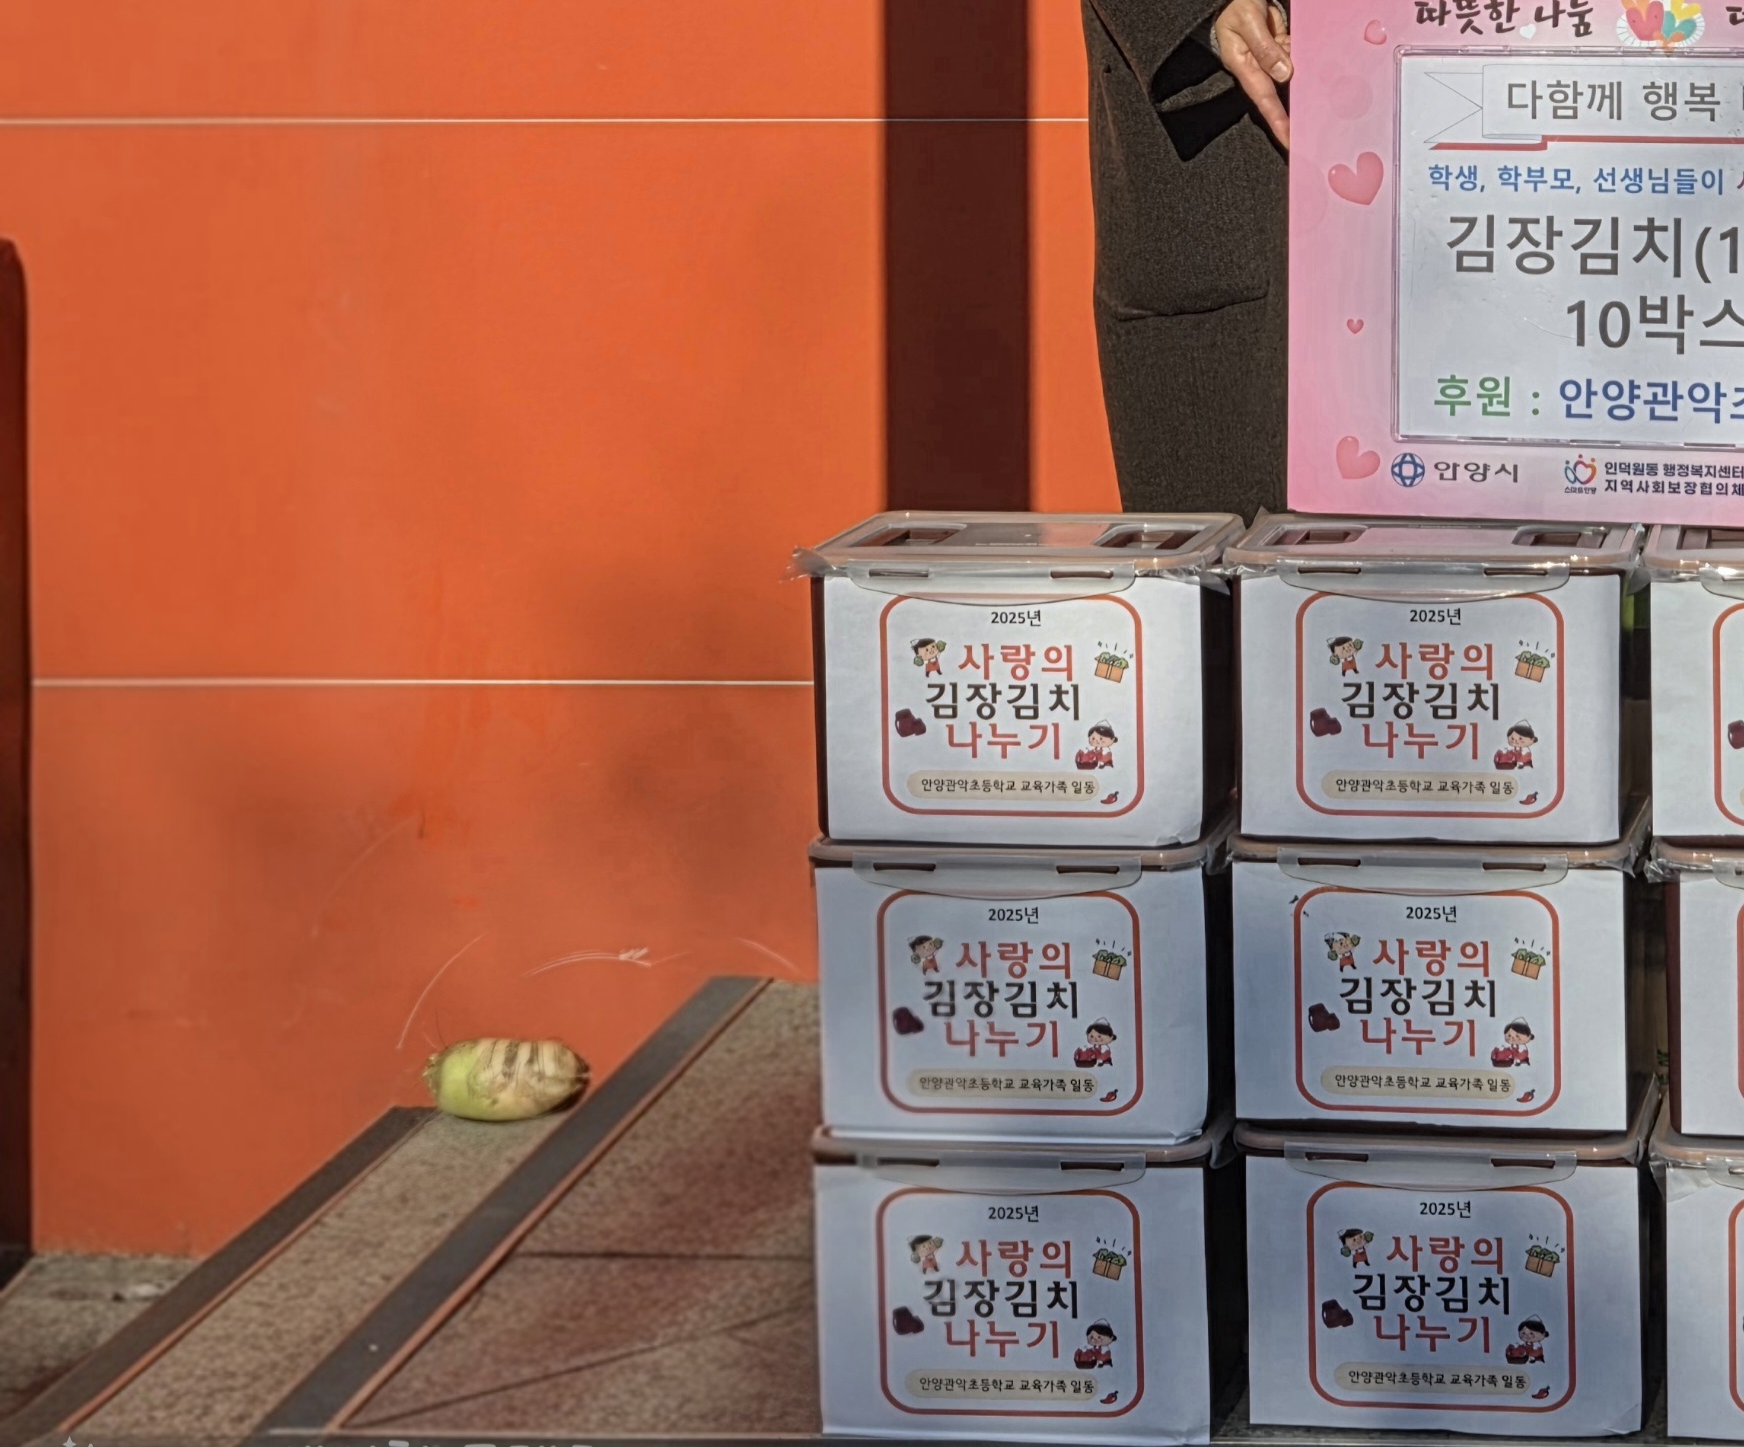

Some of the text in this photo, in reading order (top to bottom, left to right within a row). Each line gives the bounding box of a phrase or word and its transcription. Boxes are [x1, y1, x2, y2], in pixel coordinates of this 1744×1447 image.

[1507, 79, 1622, 121] 다함께
[1642, 81, 1721, 122] 행복
[1428, 164, 1486, 193] 학생,
[1498, 165, 1582, 195] 학부모,
[1593, 167, 1723, 196] 선생님들이
[1434, 374, 1511, 418] 후원
[1433, 461, 1519, 483] 안양시
[1604, 462, 1744, 479] 인덕원동 행정복지센터
[1604, 479, 1744, 496] 지역사회보장협의체
[990, 609, 1042, 627] 2025년
[1409, 607, 1462, 626] 2025년
[957, 642, 1074, 682] 사랑의
[1374, 641, 1494, 681] 사랑의
[925, 681, 1080, 721] 김장김치
[1341, 680, 1500, 721] 김장김치
[945, 721, 1060, 760] 나누기
[1361, 720, 1479, 761] 나누기
[921, 777, 1096, 795] 안양관악초등학교 교육가족 일동
[1335, 778, 1515, 796] 안양관악초등학교 교육가족 일동
[987, 906, 1039, 924] 2025년
[1405, 904, 1458, 922] 2025년
[955, 940, 1071, 980] 사랑의
[1372, 937, 1490, 978] 사랑의
[923, 979, 1078, 1019] 김장김치
[1339, 976, 1496, 1018] 김장김치
[943, 1019, 1059, 1058] 나누기
[1359, 1016, 1476, 1057] 나누기
[919, 1075, 1095, 1093] 안양관악초등학교 교육가족 일동
[1334, 1073, 1512, 1093] 안양관악초등학교 교육가족 일동
[987, 1204, 1040, 1223] 2025년
[1419, 1200, 1472, 1219] 2025년
[955, 1238, 1072, 1279] 사랑의
[1385, 1233, 1504, 1275] 사랑의
[923, 1278, 1079, 1319] 김장김치
[1353, 1272, 1510, 1315] 김장김치
[943, 1319, 1059, 1359] 나누기
[1373, 1312, 1490, 1354] 나누기
[919, 1376, 1095, 1395] 안양관악초등학교 교육가족 일동
[1348, 1369, 1527, 1390] 안양관악초등학교 교육가족 일동
